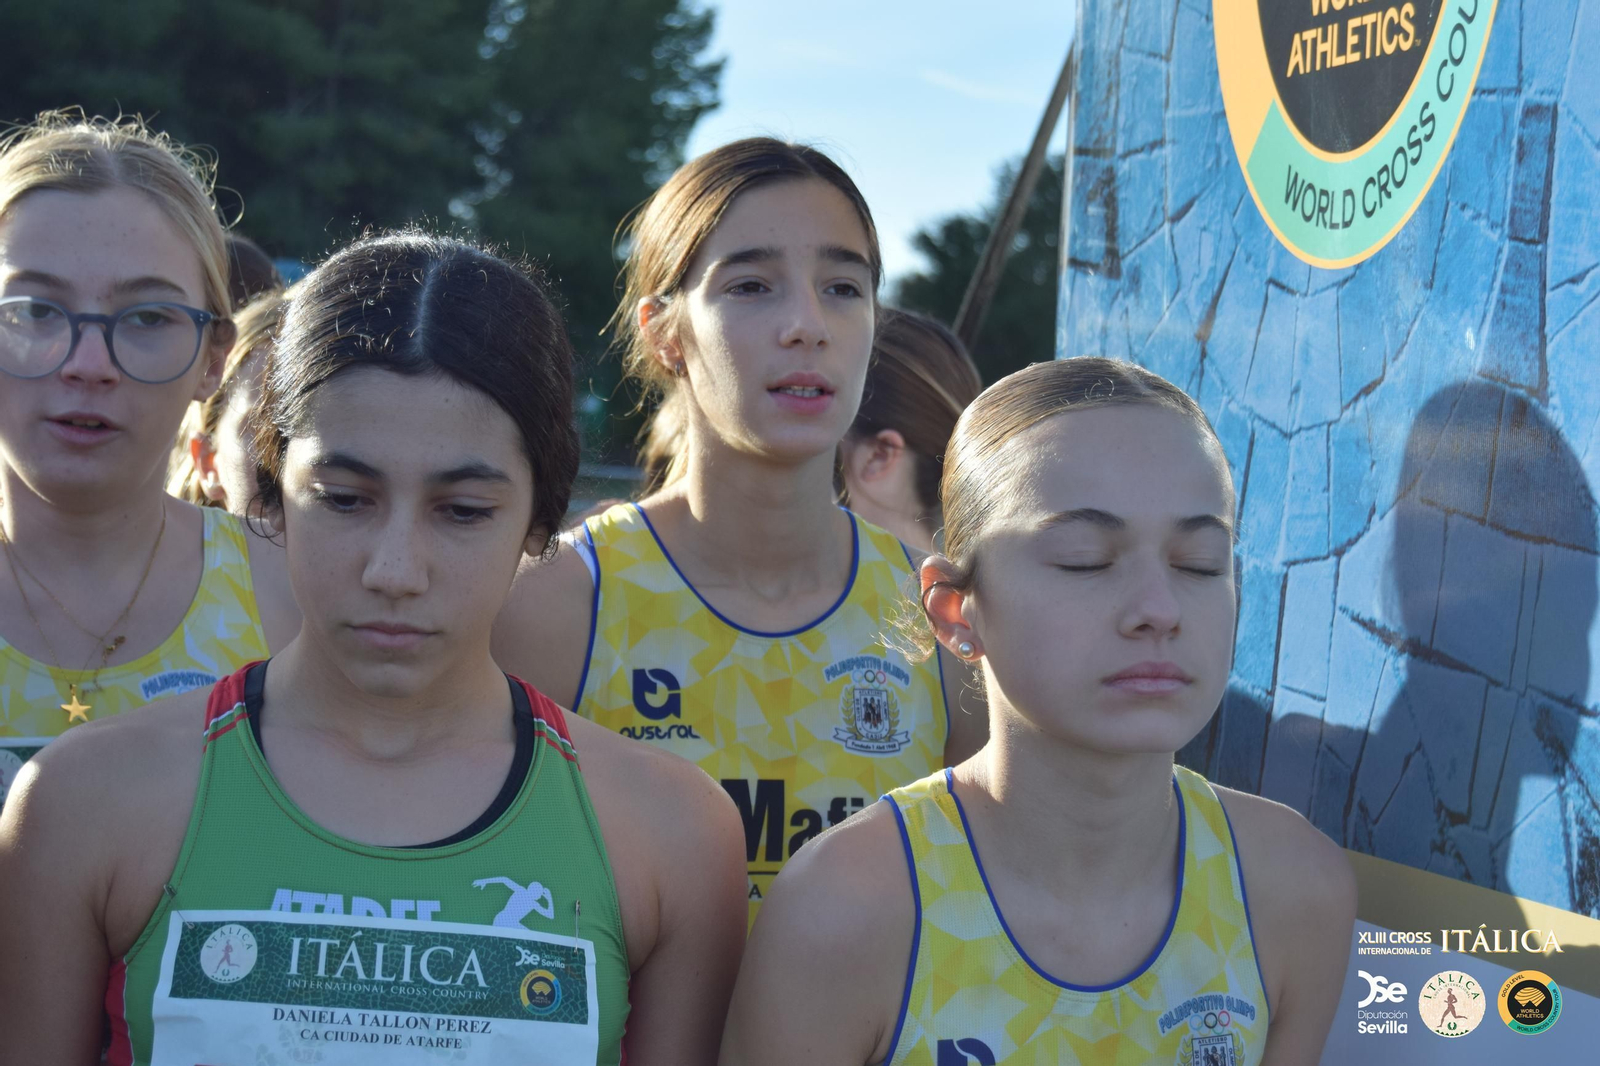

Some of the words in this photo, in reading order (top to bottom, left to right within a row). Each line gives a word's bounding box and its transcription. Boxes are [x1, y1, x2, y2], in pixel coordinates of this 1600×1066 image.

[1286, 2, 1415, 78] ATHLETICS
[1284, 164, 1356, 231] WORLD
[1362, 101, 1436, 219] CROSS
[619, 724, 701, 740] austral
[286, 930, 490, 988] ITÁLICA
[541, 959, 565, 969] Sevilla
[287, 979, 384, 994] INTERNATIONAL
[390, 985, 427, 996] CROSS
[432, 988, 490, 1000] COUNTRY
[273, 1008, 352, 1026] DANIELA
[358, 1013, 431, 1030] TALLON
[436, 1018, 492, 1034] PEREZ
[300, 1028, 320, 1041] CA
[324, 1030, 379, 1044] CIUDAD
[383, 1034, 402, 1046] DE
[405, 1036, 463, 1049] ATARFE
